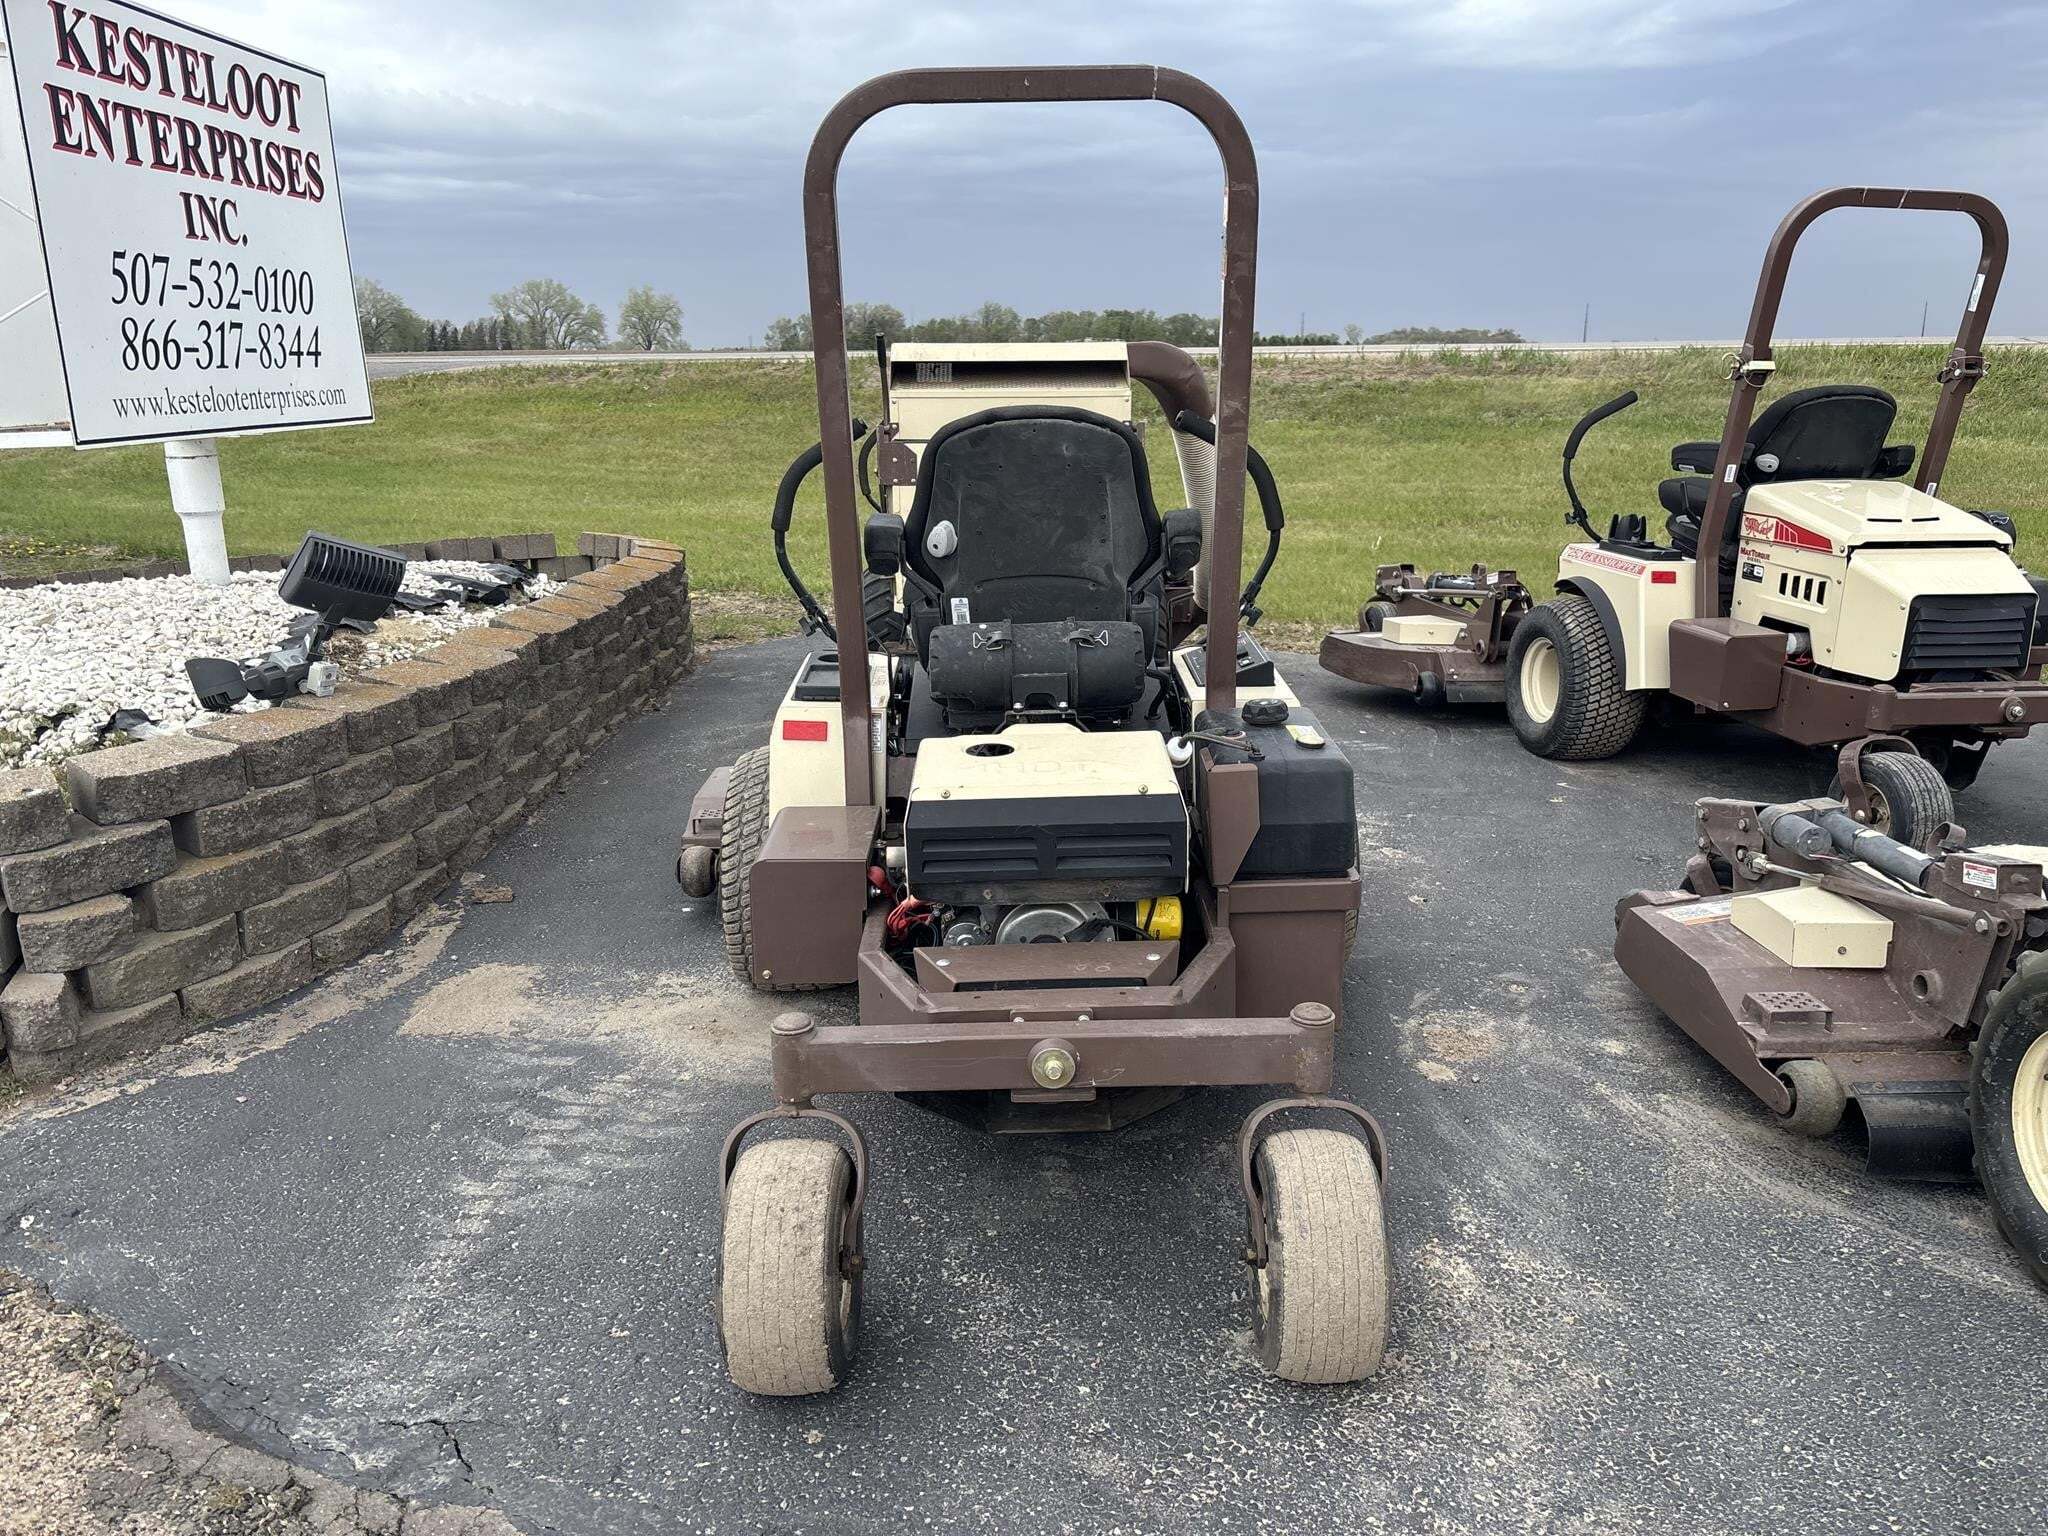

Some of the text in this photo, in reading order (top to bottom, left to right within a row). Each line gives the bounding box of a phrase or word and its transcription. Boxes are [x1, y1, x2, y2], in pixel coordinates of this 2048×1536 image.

[48, 0, 301, 132] KESTELOOT
[43, 82, 325, 203] ENTERPRISES
[179, 192, 249, 247] INC.
[111, 249, 315, 315] 507-532-0100
[121, 317, 322, 371] 866-317-8344
[112, 385, 347, 419] www.kestelootenterprises.com
